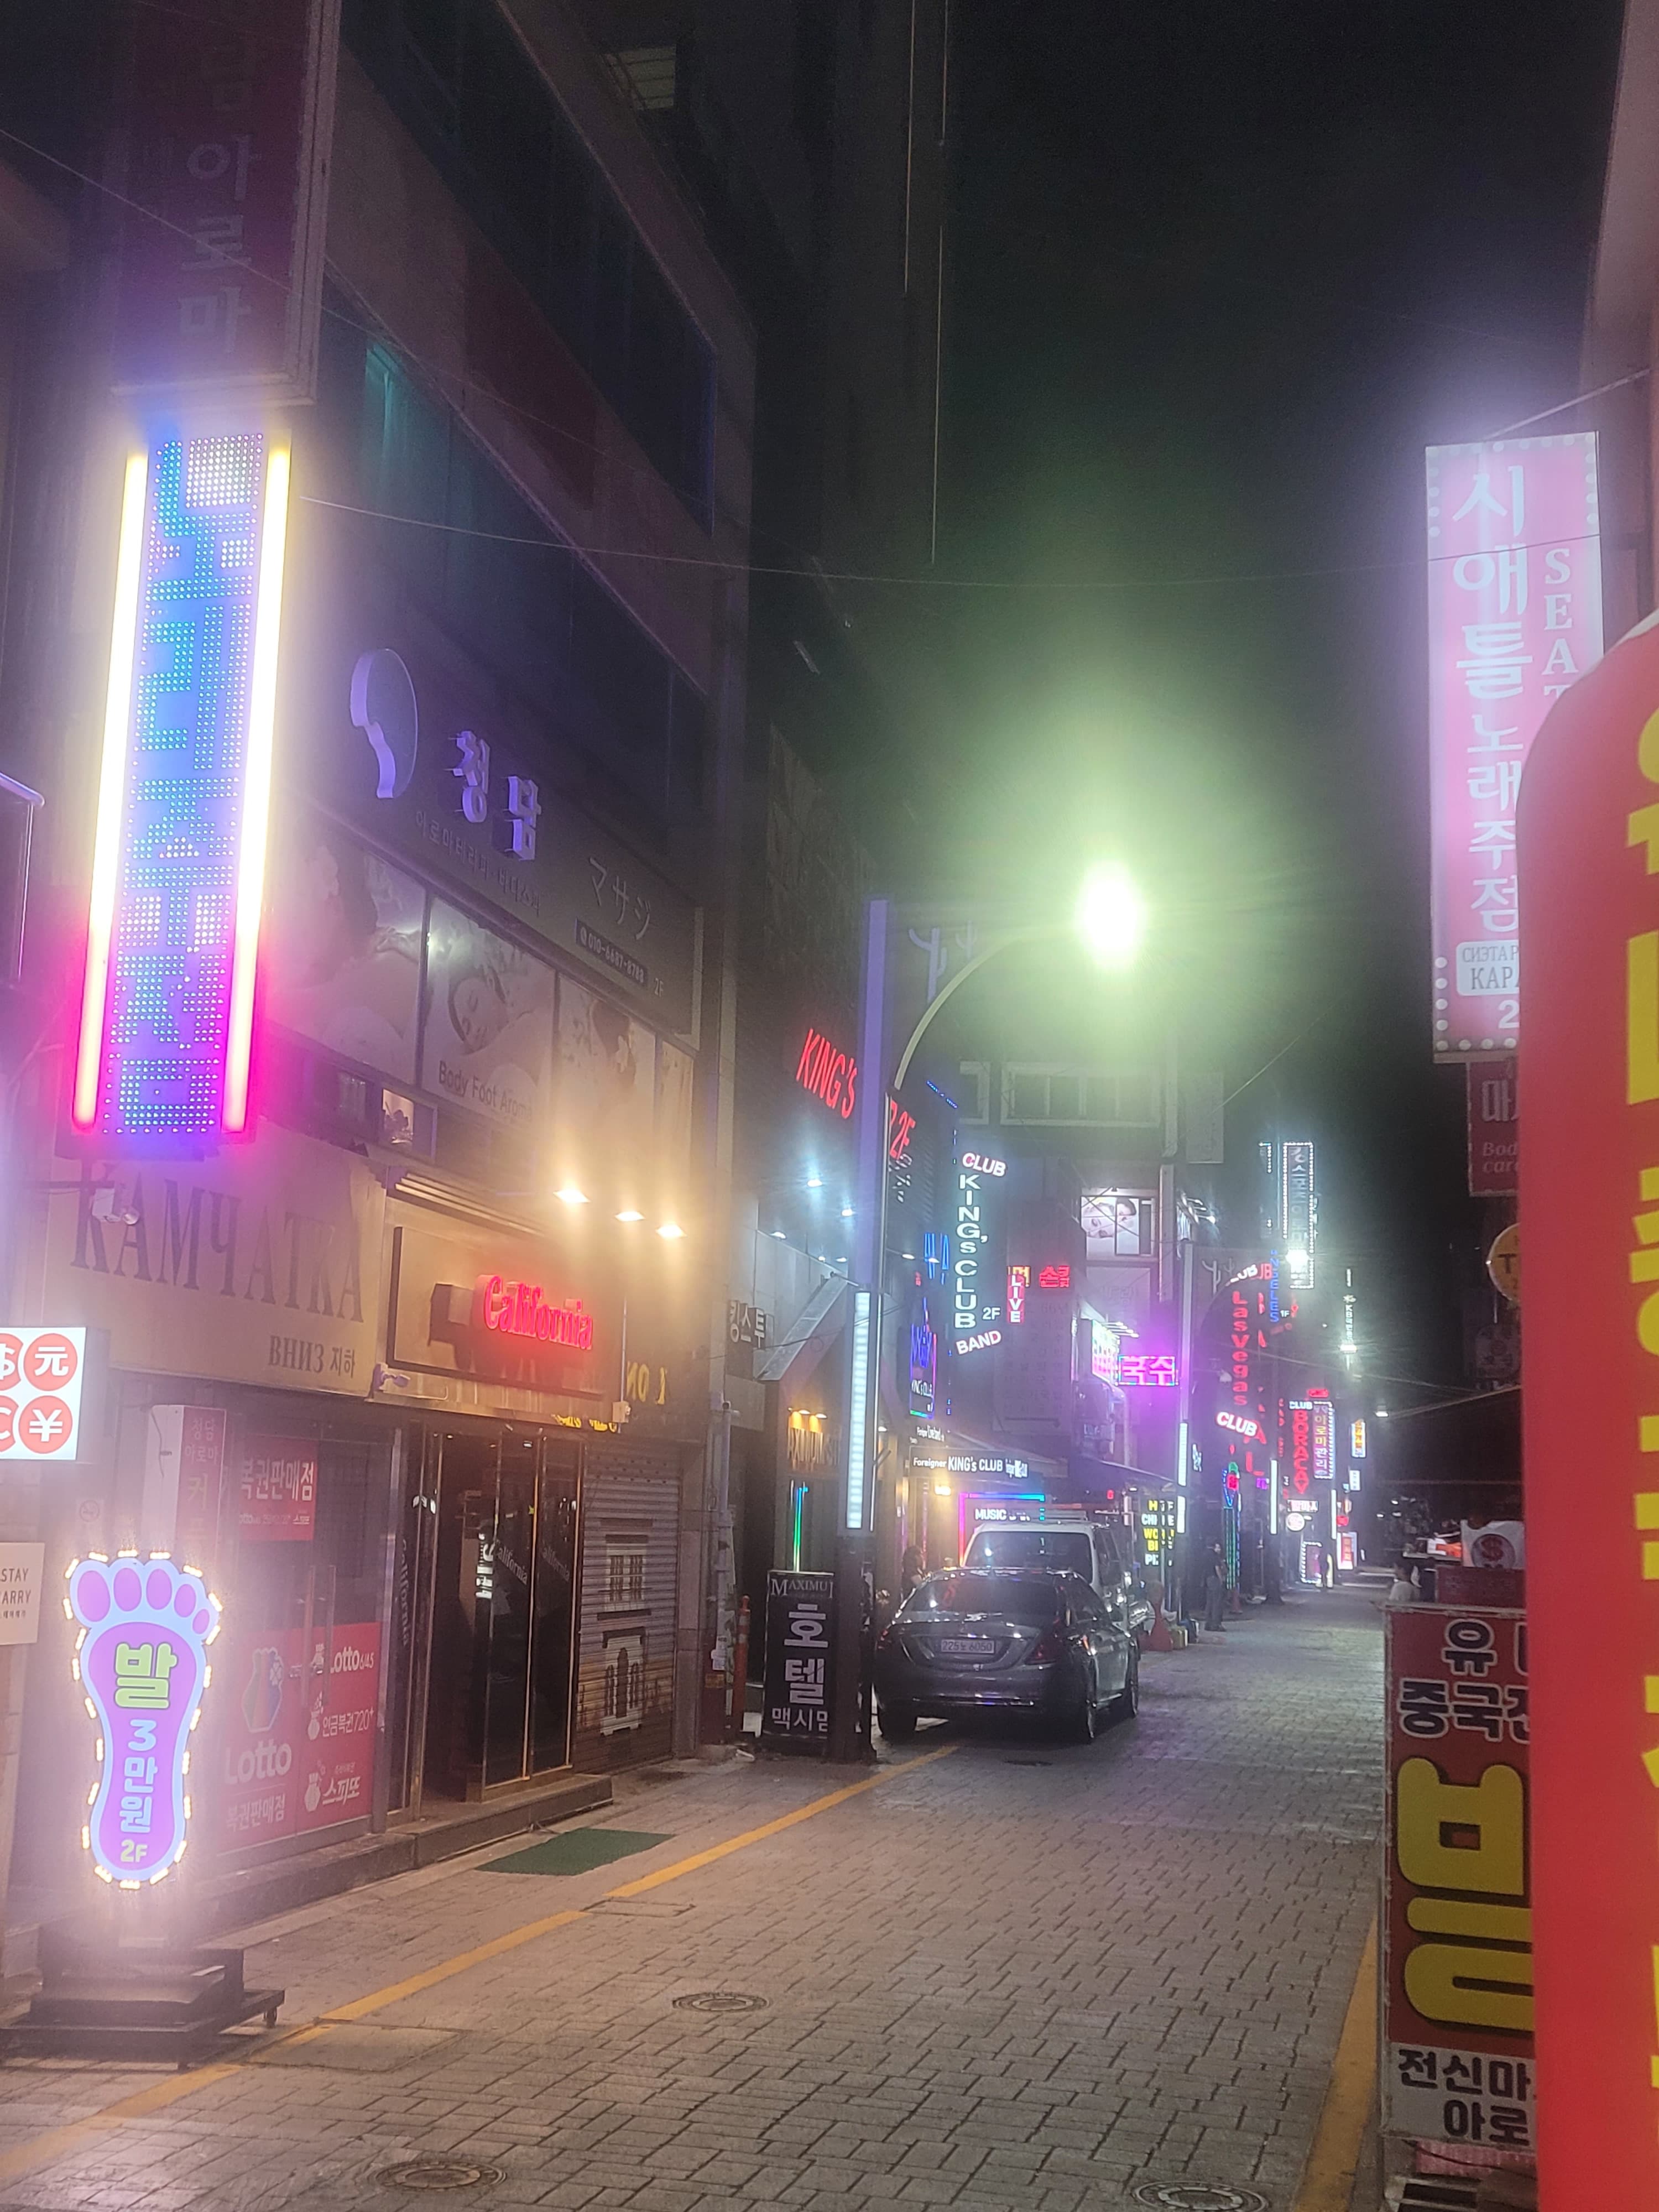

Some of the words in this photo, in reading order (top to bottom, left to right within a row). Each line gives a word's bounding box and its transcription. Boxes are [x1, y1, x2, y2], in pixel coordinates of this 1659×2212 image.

[1452, 465, 1533, 700] 시애틀
[453, 731, 542, 861] 청담
[1467, 713, 1524, 933] 노래주점
[654, 978, 664, 997] 2F
[1471, 966, 1519, 990] КАР
[437, 1060, 468, 1098] Body
[472, 1076, 498, 1108] Foot
[796, 1028, 857, 1119] KING'S
[1481, 1079, 1520, 1122] 마
[962, 1152, 1006, 1177] CLUB
[483, 1274, 594, 1350] California
[954, 1260, 978, 1328] CLUB
[982, 1306, 1001, 1321] 2F
[1010, 1275, 1023, 1323] LIVE
[34, 1345, 69, 1377] 元
[268, 1334, 325, 1375] ВНИЗ
[330, 1346, 356, 1378] 지하
[956, 1329, 1002, 1355] BAND
[1217, 1412, 1258, 1437] CLUB
[1289, 1401, 1313, 1410] CLUB
[914, 1457, 947, 1469] Foreigner
[948, 1455, 977, 1472] KING's
[979, 1459, 1003, 1472] CLUB
[974, 1507, 1007, 1521] MUSIC
[0, 1589, 32, 1606] ARRY
[771, 1578, 833, 1599] MAXIMU
[114, 1642, 178, 1709] 발
[784, 1603, 829, 1705] 호텔
[119, 1719, 158, 1833] 3만원
[224, 1739, 293, 1785] Lotto
[226, 1794, 286, 1829] 복권판매점
[120, 1839, 148, 1863] 2F
[1398, 2049, 1536, 2102] 전신마
